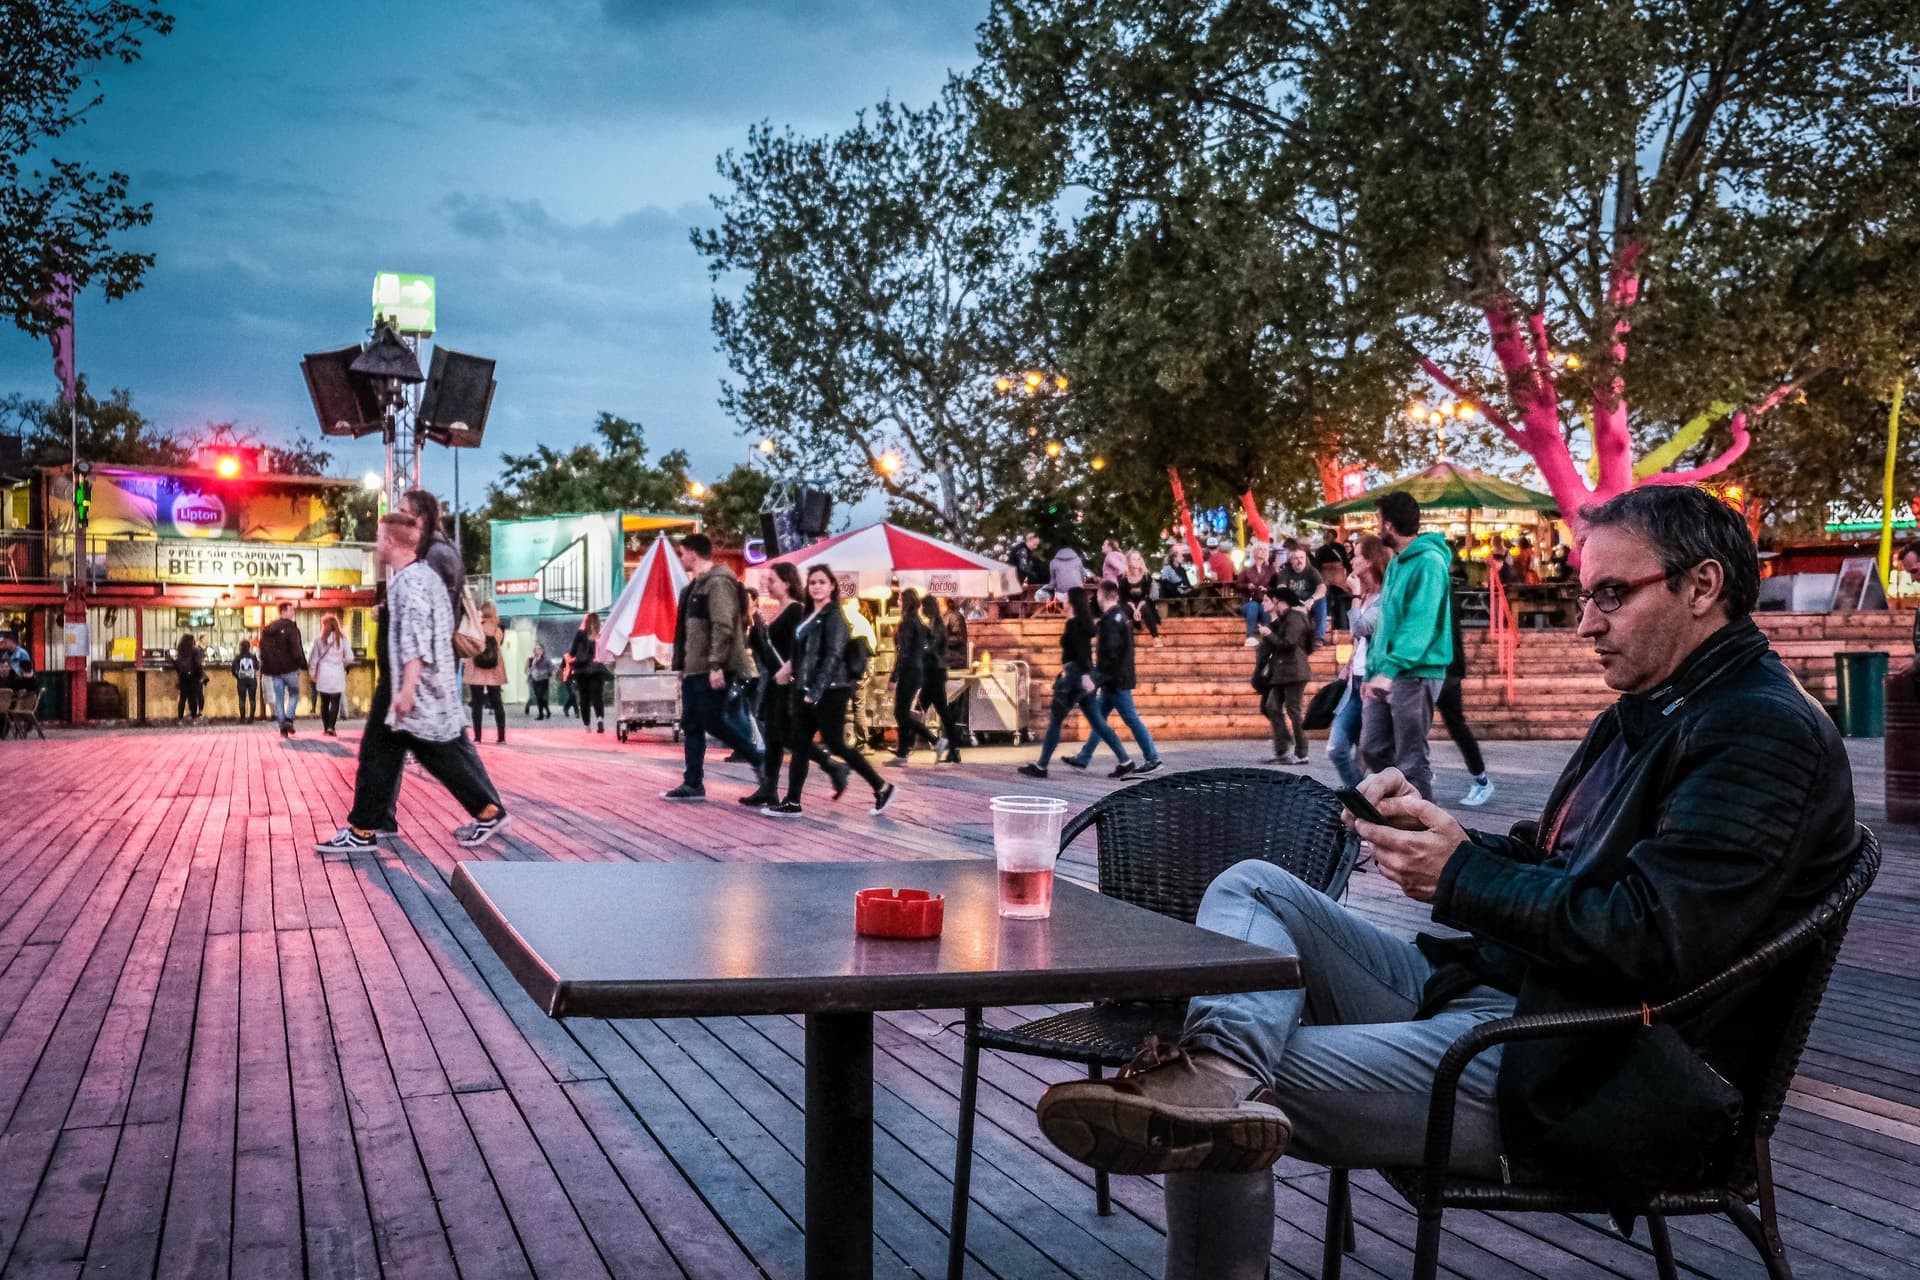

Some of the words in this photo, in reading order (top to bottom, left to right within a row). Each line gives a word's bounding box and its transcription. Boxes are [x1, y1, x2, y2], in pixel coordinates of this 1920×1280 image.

[180, 508, 217, 521] Lipton
[168, 559, 223, 575] BEER
[234, 561, 292, 577] POINT
